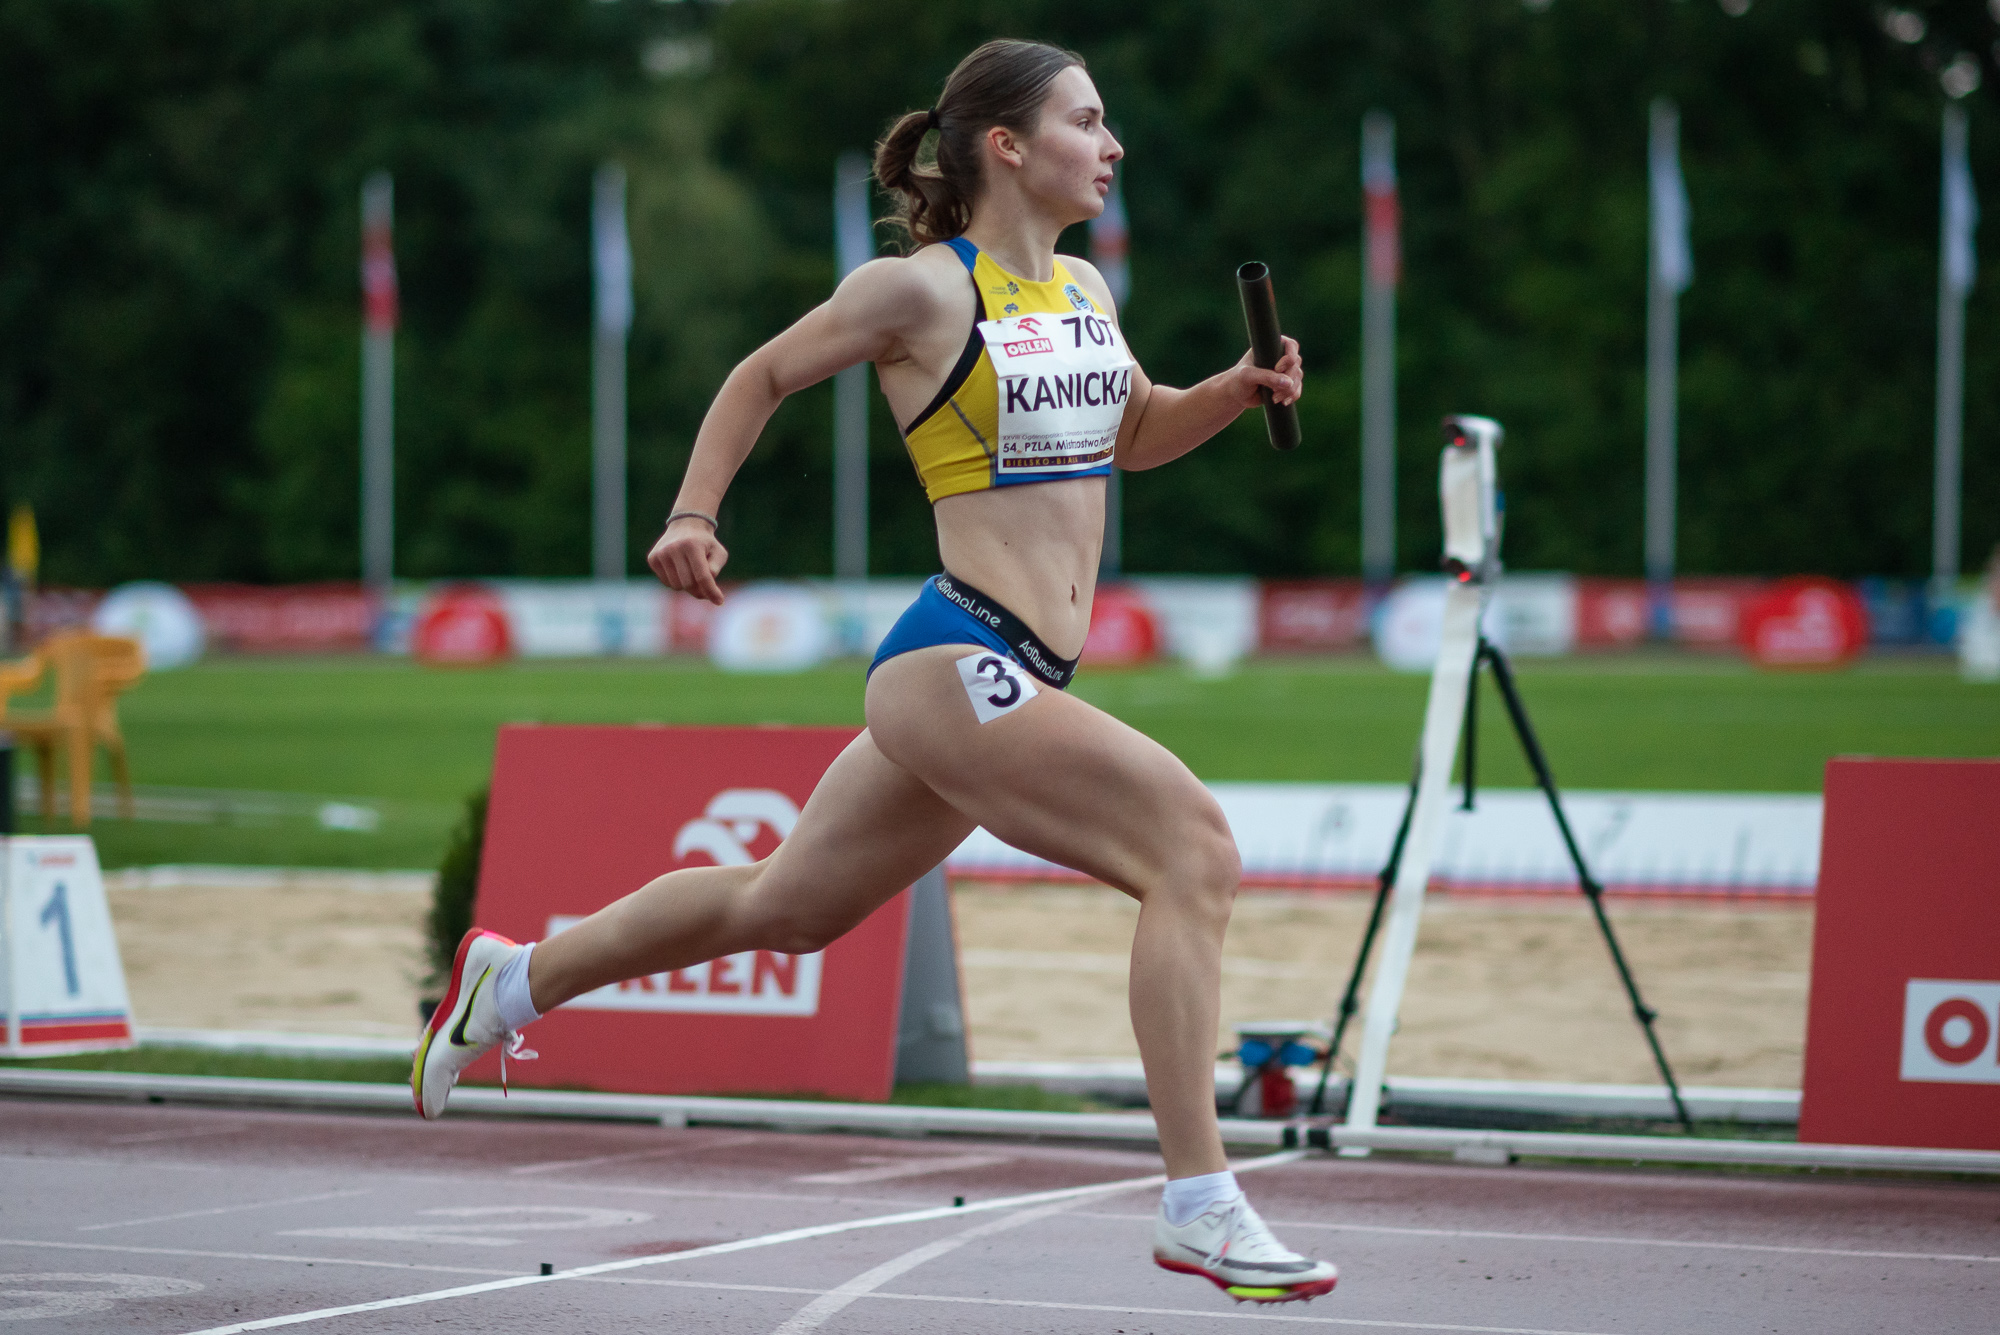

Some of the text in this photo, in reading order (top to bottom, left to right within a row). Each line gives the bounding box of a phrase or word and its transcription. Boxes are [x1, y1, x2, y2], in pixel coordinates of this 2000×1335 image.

[1008, 338, 1051, 355] ORLEN
[1006, 370, 1128, 413] KANICKA
[1025, 441, 1052, 452] PZLA
[977, 656, 1021, 708] 3
[41, 881, 80, 997] 1
[619, 949, 797, 995] LEN
[1923, 997, 2000, 1067] O
